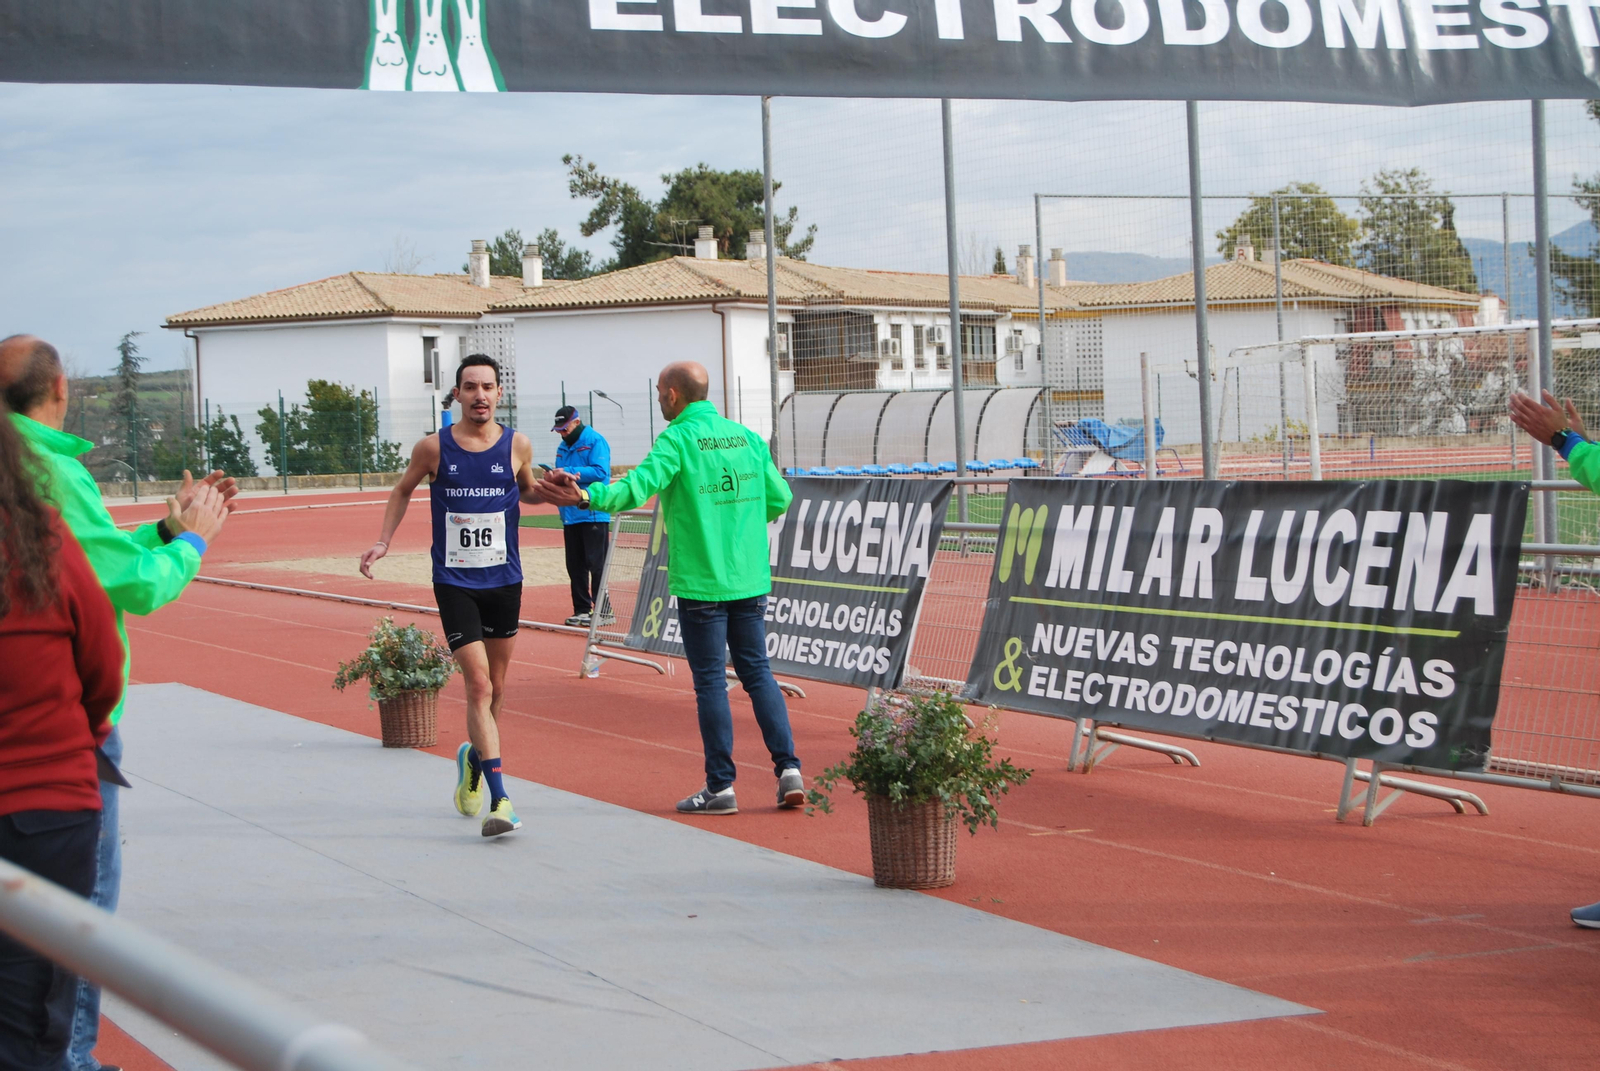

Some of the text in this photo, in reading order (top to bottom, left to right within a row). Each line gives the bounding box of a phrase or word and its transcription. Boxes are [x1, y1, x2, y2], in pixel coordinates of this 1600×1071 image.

[445, 487, 506, 498] TROTASIERRA
[460, 527, 493, 548] 616
[791, 499, 932, 578] LUCENA
[1045, 504, 1224, 599] MILAR
[1234, 508, 1495, 616] LUCENA
[764, 596, 902, 638] ECNOLOGÍAS
[1031, 622, 1456, 698] NUEVAS TECNOLOGÍAS
[1027, 665, 1439, 749] ELECTRODOMESTICOS
